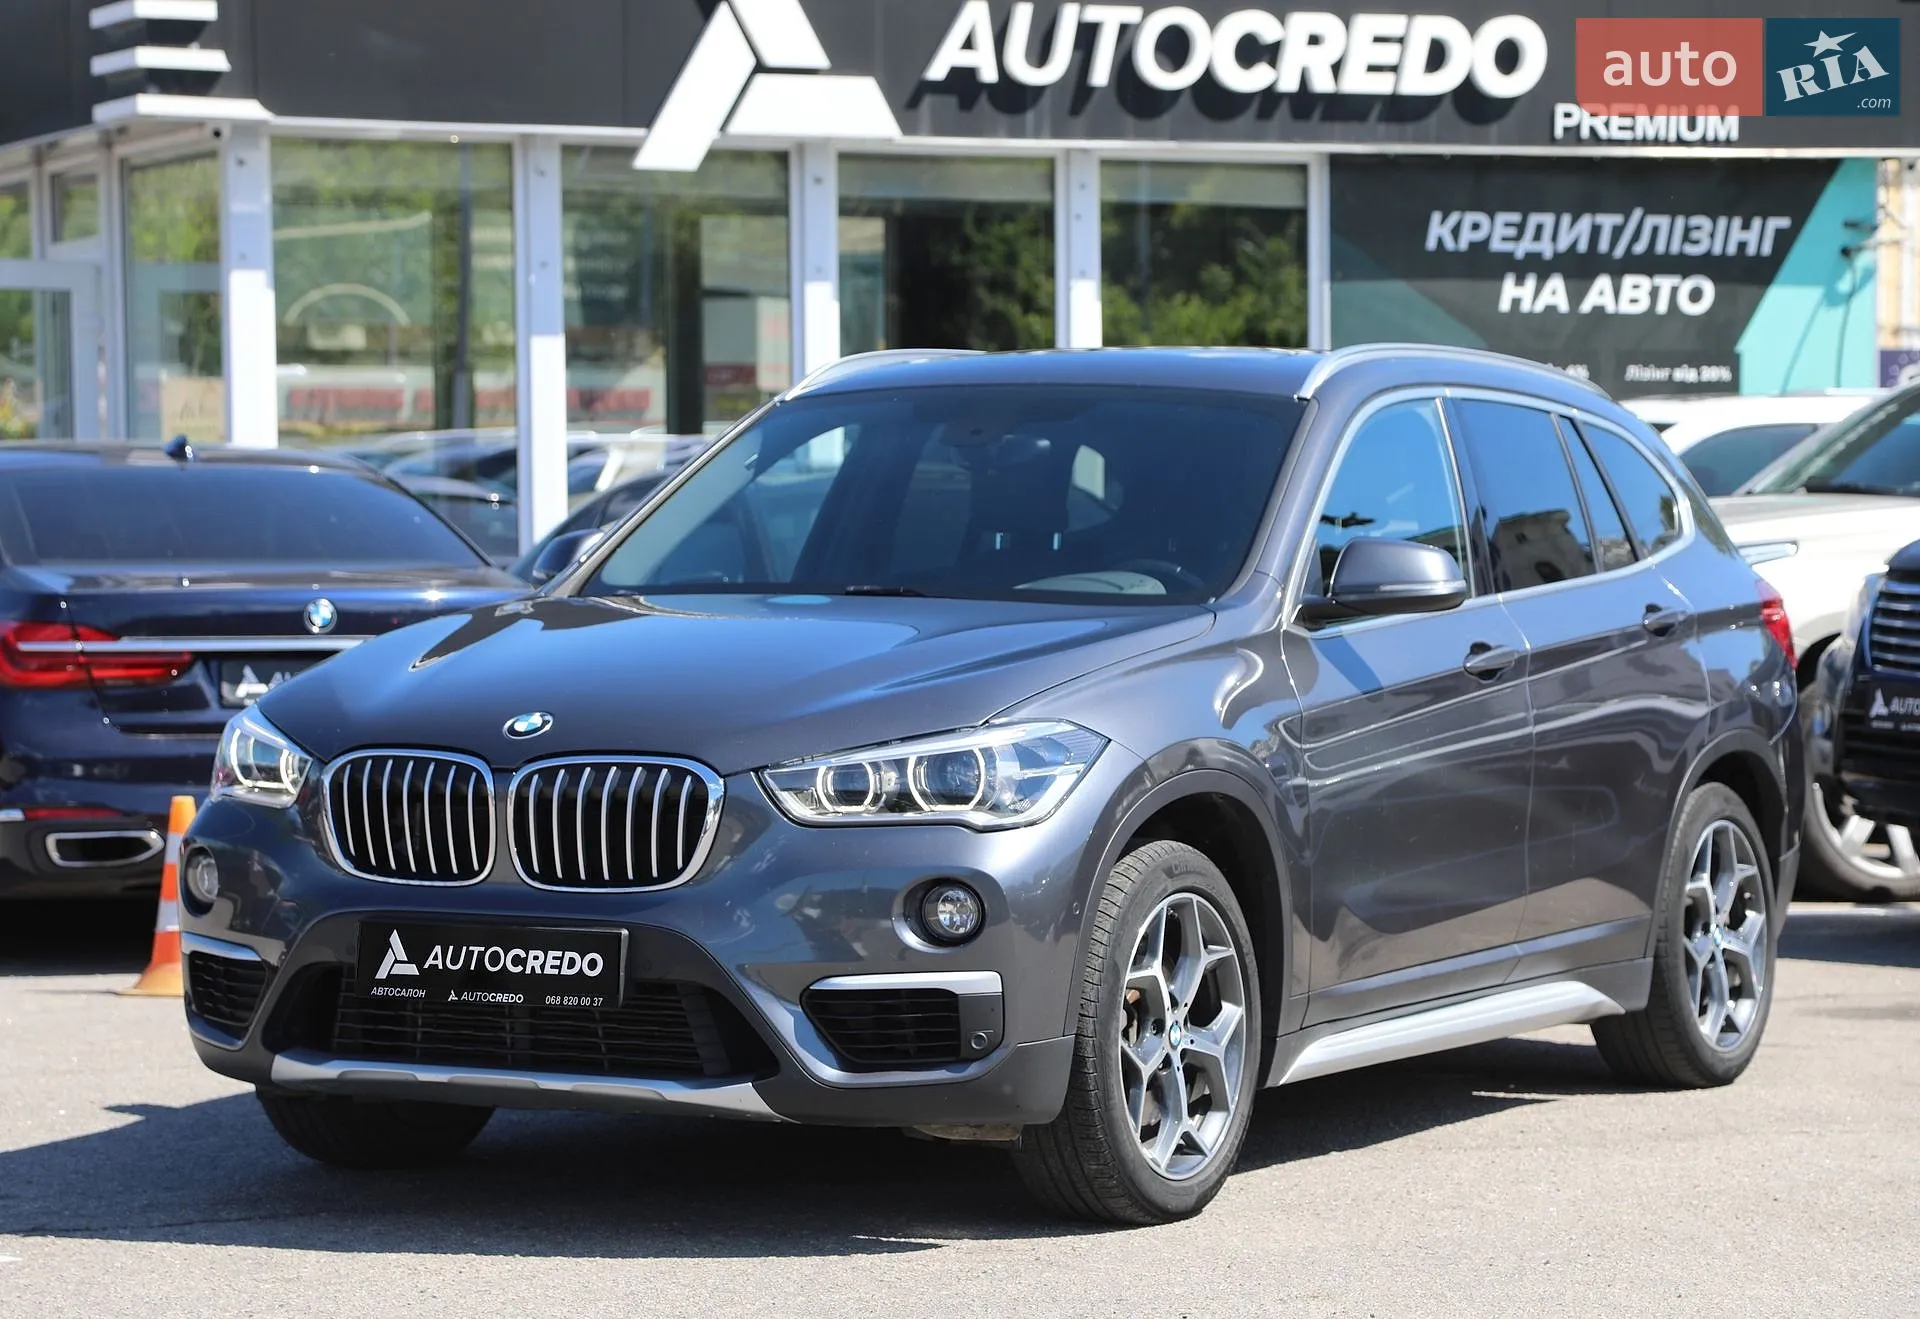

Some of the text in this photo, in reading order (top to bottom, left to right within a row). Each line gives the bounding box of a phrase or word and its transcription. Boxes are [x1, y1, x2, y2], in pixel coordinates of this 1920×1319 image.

[925, 0, 1548, 99] AUTOCREDO
[1553, 102, 1740, 142] PREMIUM
[1425, 207, 1792, 260] КРЕДИТ/ЛІЗІНГ
[1498, 272, 1717, 316] НА АВТО
[423, 945, 604, 977] AUTOCREDO
[371, 986, 426, 998] АВТОСАЛОН
[460, 991, 524, 1004] AUTOCREDO
[545, 995, 603, 1007] 068 820 00 37
